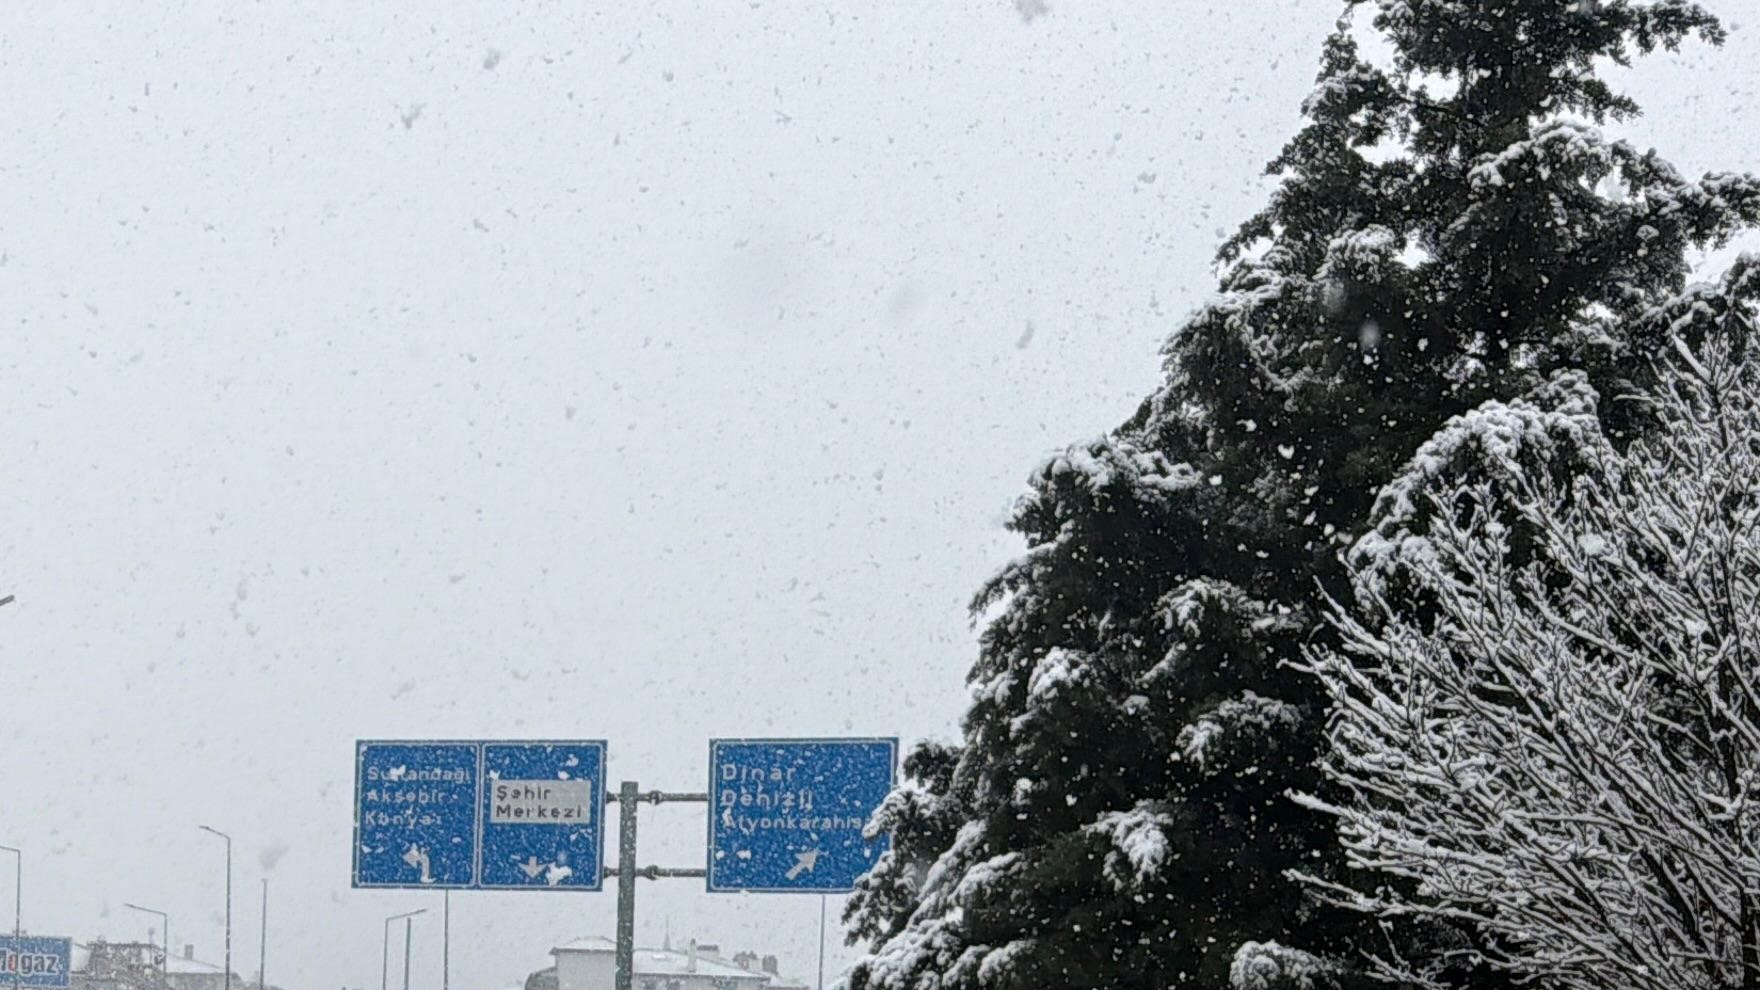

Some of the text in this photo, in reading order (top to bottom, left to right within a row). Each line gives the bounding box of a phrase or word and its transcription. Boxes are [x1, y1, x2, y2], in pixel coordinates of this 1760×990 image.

[723, 764, 796, 782] Dinar
[496, 785, 551, 801] Şehir
[720, 788, 813, 810] Denizli
[495, 804, 582, 819] Merkezi
